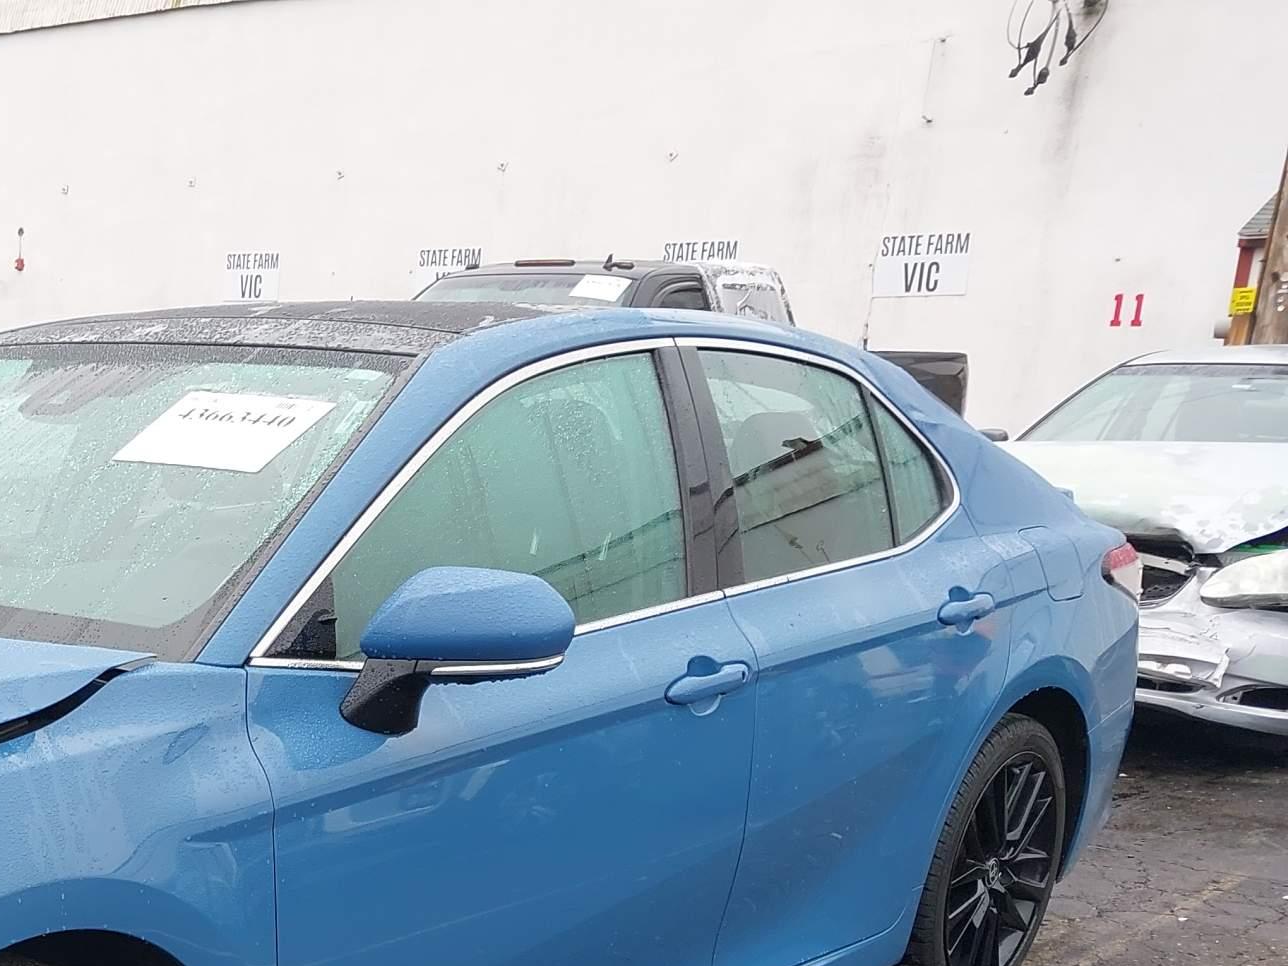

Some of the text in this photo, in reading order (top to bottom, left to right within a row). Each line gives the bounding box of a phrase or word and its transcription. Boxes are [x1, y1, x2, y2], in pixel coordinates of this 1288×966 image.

[418, 247, 481, 267] STATE FARM
[663, 240, 739, 262] STATE FARM
[881, 233, 971, 257] STATE FARM
[226, 252, 280, 270] STATE FARM
[240, 274, 263, 299] VIC
[903, 261, 941, 293] VIC
[1109, 293, 1145, 327] 11
